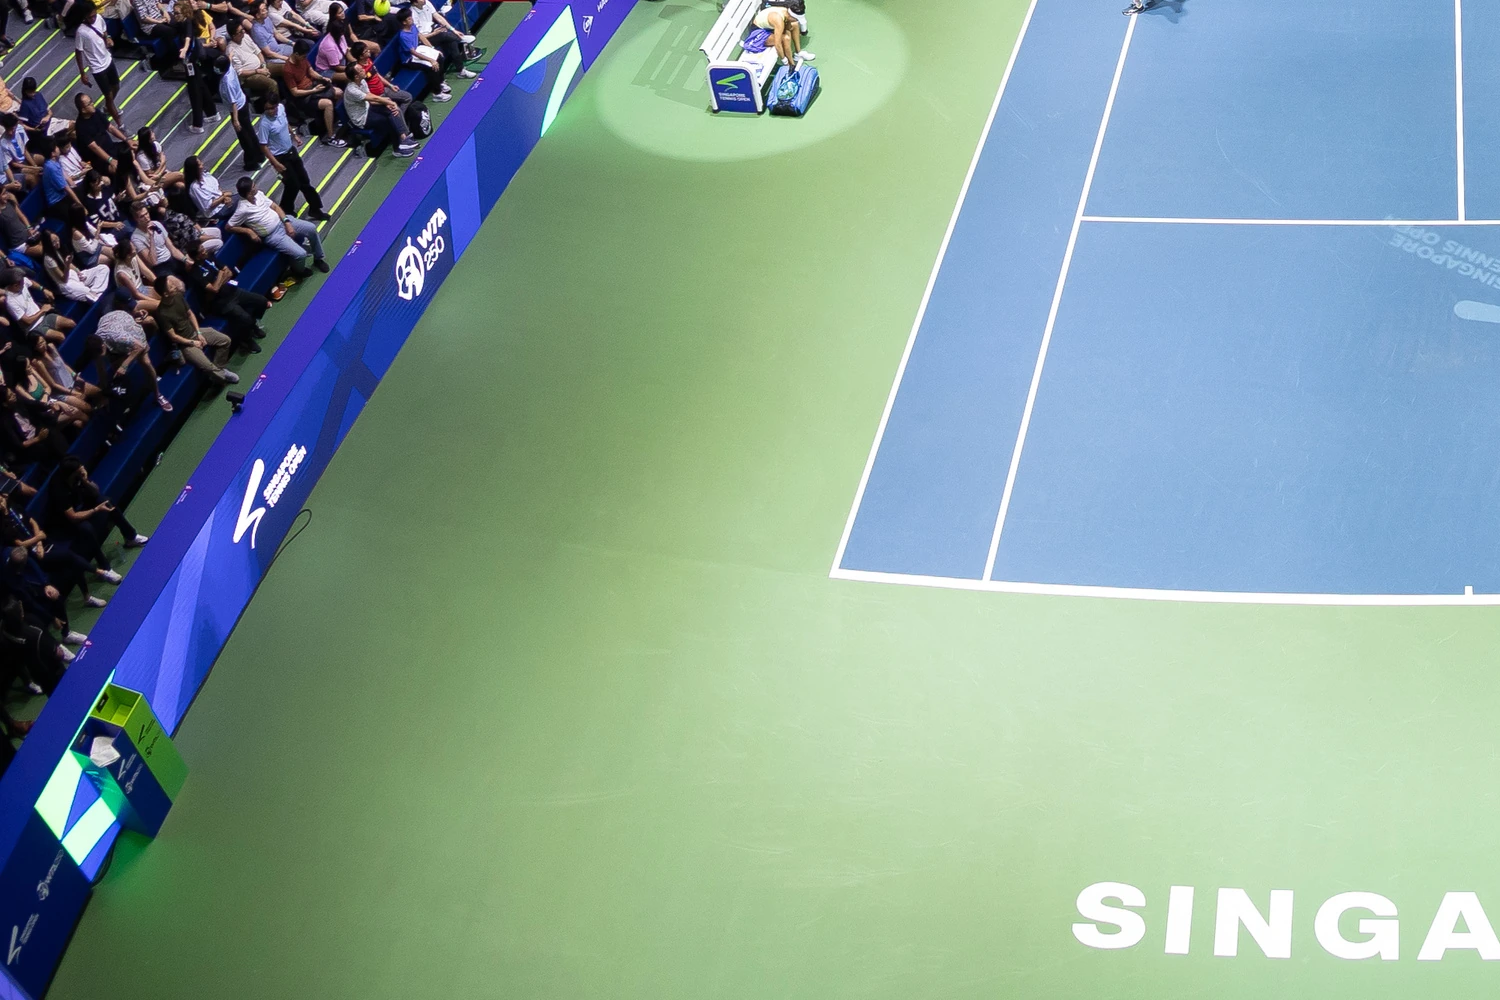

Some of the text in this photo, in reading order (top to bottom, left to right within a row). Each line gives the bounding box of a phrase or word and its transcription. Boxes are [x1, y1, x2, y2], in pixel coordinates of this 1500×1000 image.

[417, 207, 447, 249] WTA
[424, 236, 444, 271] 250
[263, 443, 298, 501] SINGAPORE
[289, 445, 307, 475] OPEN
